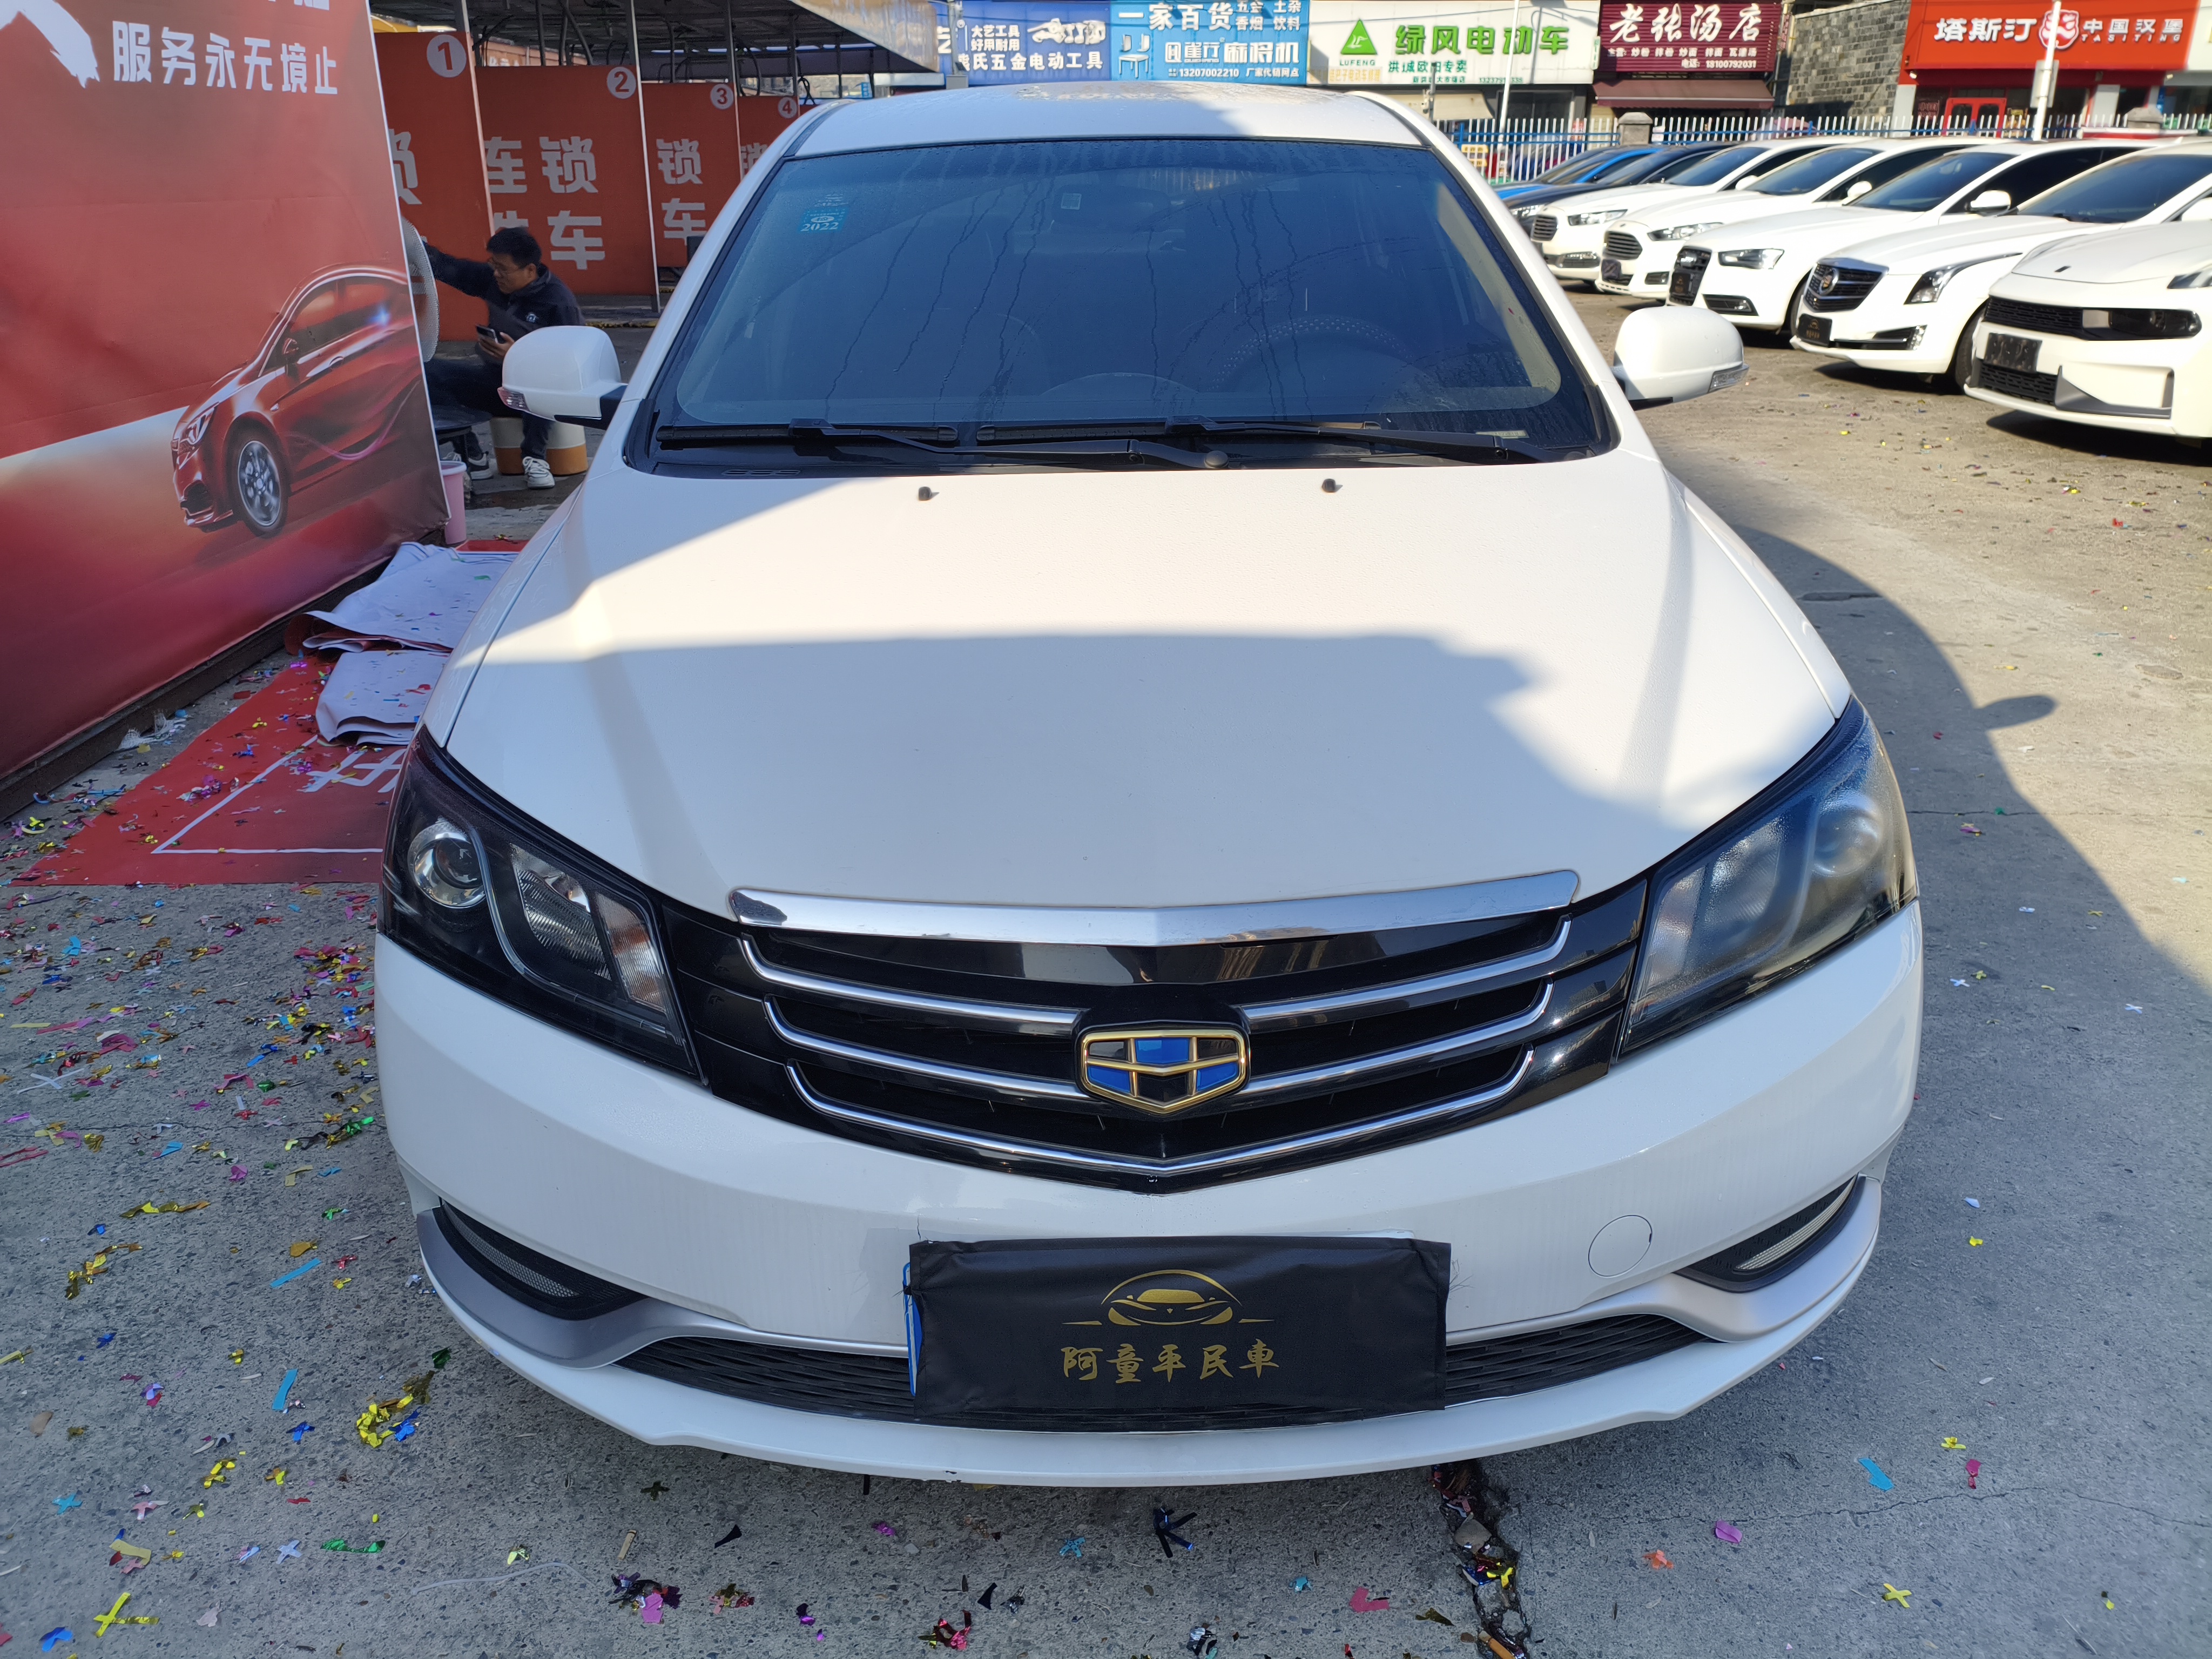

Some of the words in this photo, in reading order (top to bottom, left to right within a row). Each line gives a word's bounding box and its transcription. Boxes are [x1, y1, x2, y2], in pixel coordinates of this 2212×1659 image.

[1118, 2, 1234, 31] 一家百货
[1235, 16, 1263, 31] 香烟
[1273, 16, 1300, 31] 饮料
[1609, 3, 1762, 44] 老张汤店
[2082, 18, 2184, 34] 中国汉堡
[971, 24, 1020, 38] 大艺工具
[1395, 25, 1570, 55] 绿风电动车
[1933, 18, 2037, 42] 塔斯汀
[2081, 34, 2181, 42] TASITING
[970, 38, 1020, 51] 好用耐用
[1224, 42, 1300, 64] 麻将机
[112, 20, 338, 95] 服务永无境止
[437, 41, 454, 71] 1
[613, 71, 630, 93] 2
[1179, 68, 1240, 78] 13207002210
[716, 87, 728, 105] 3
[782, 99, 793, 114] 4
[656, 138, 703, 184] 锁
[660, 198, 707, 247] 车
[800, 222, 839, 232] 2022
